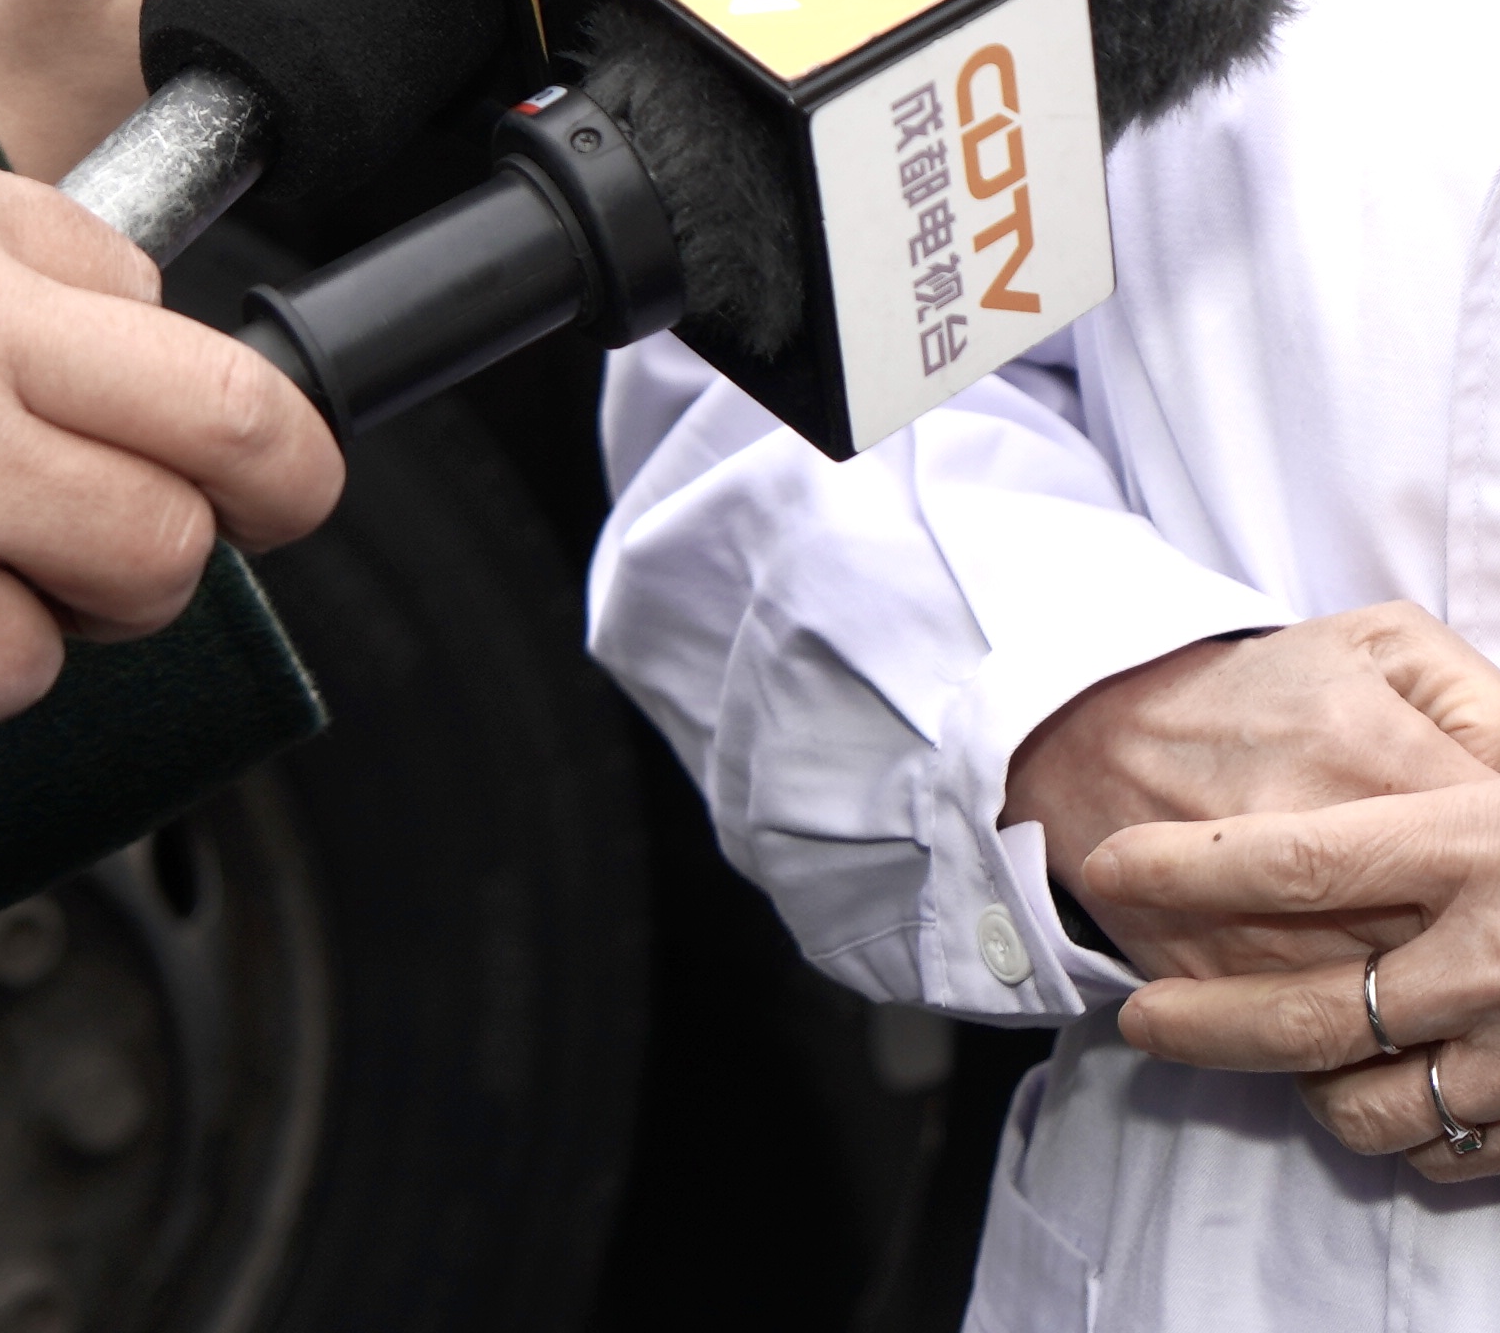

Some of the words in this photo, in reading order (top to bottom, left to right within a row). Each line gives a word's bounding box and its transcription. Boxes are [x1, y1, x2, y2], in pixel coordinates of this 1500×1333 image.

[891, 79, 969, 377] 成都电视台
[956, 42, 1042, 314] CDTV
